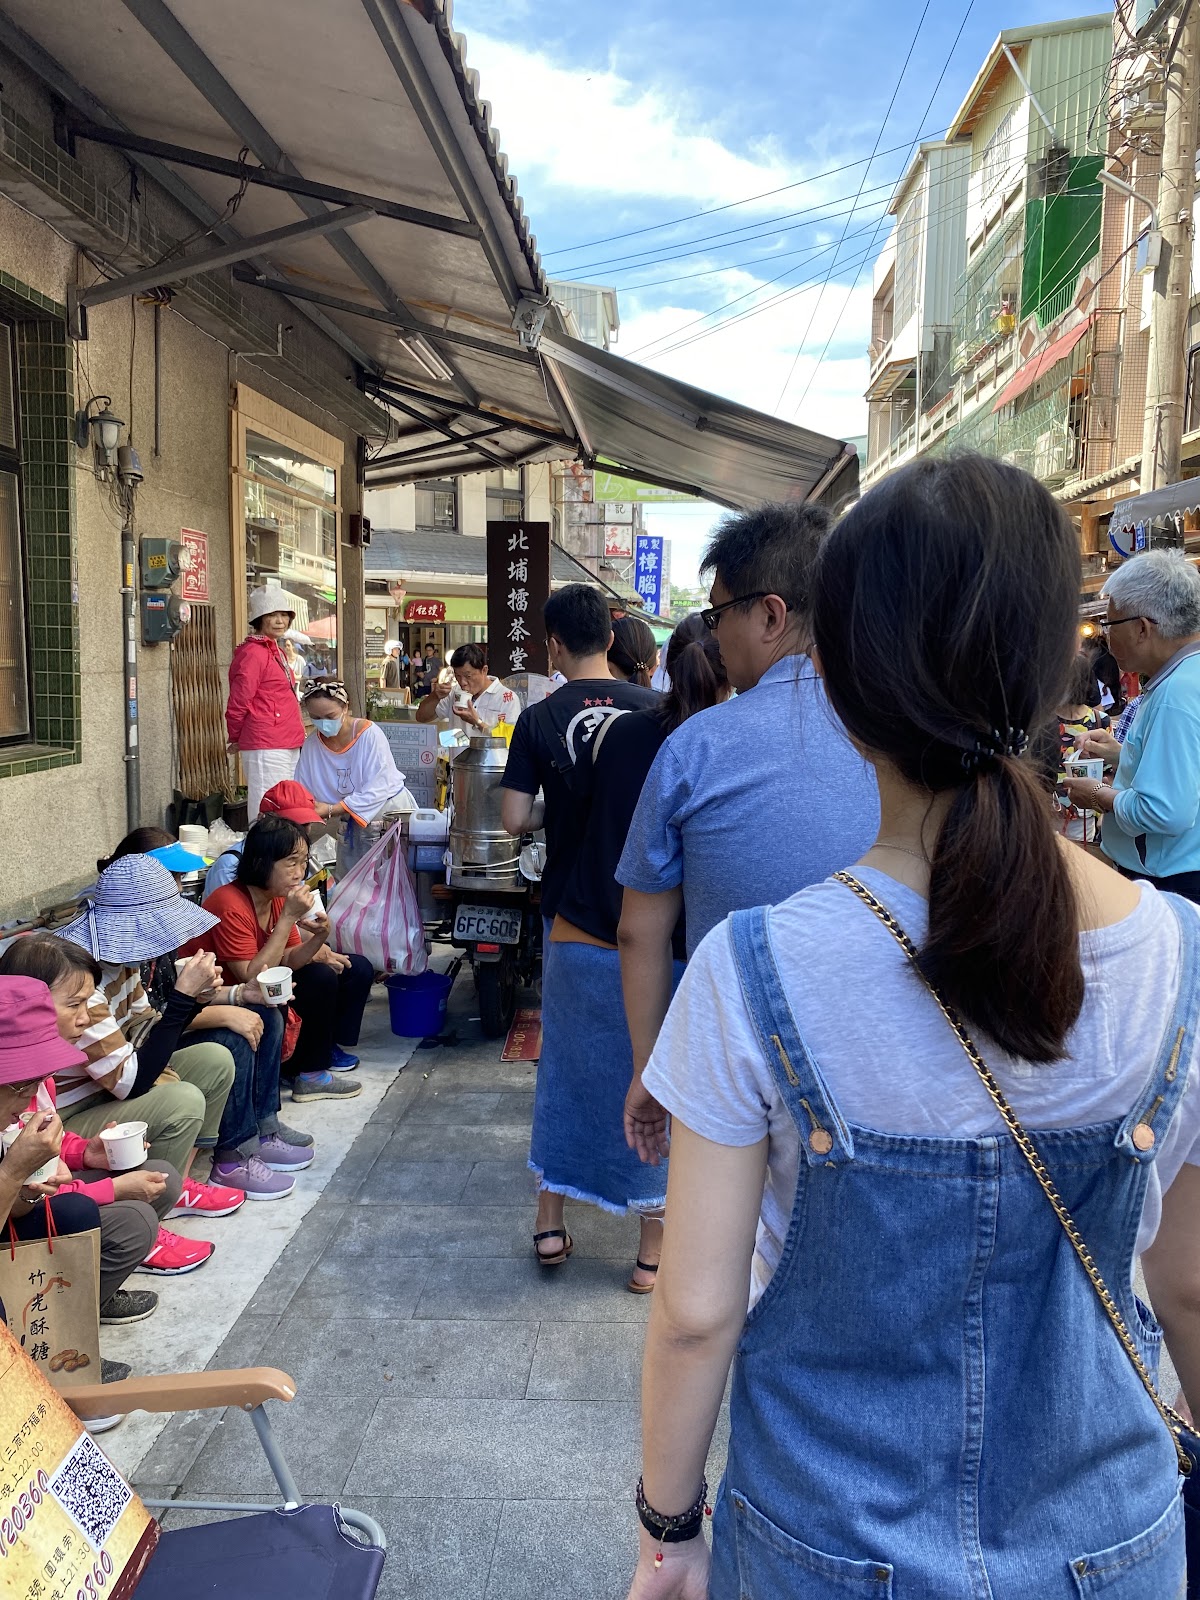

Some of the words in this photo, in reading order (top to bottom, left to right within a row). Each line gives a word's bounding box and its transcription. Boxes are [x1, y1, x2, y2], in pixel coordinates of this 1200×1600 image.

[638, 539, 661, 550] 現製
[506, 528, 531, 672] 北埔擂茶堂
[28, 1269, 51, 1362] 竹光酥糖
[0, 1398, 52, 1472] (三商巧福旁)
